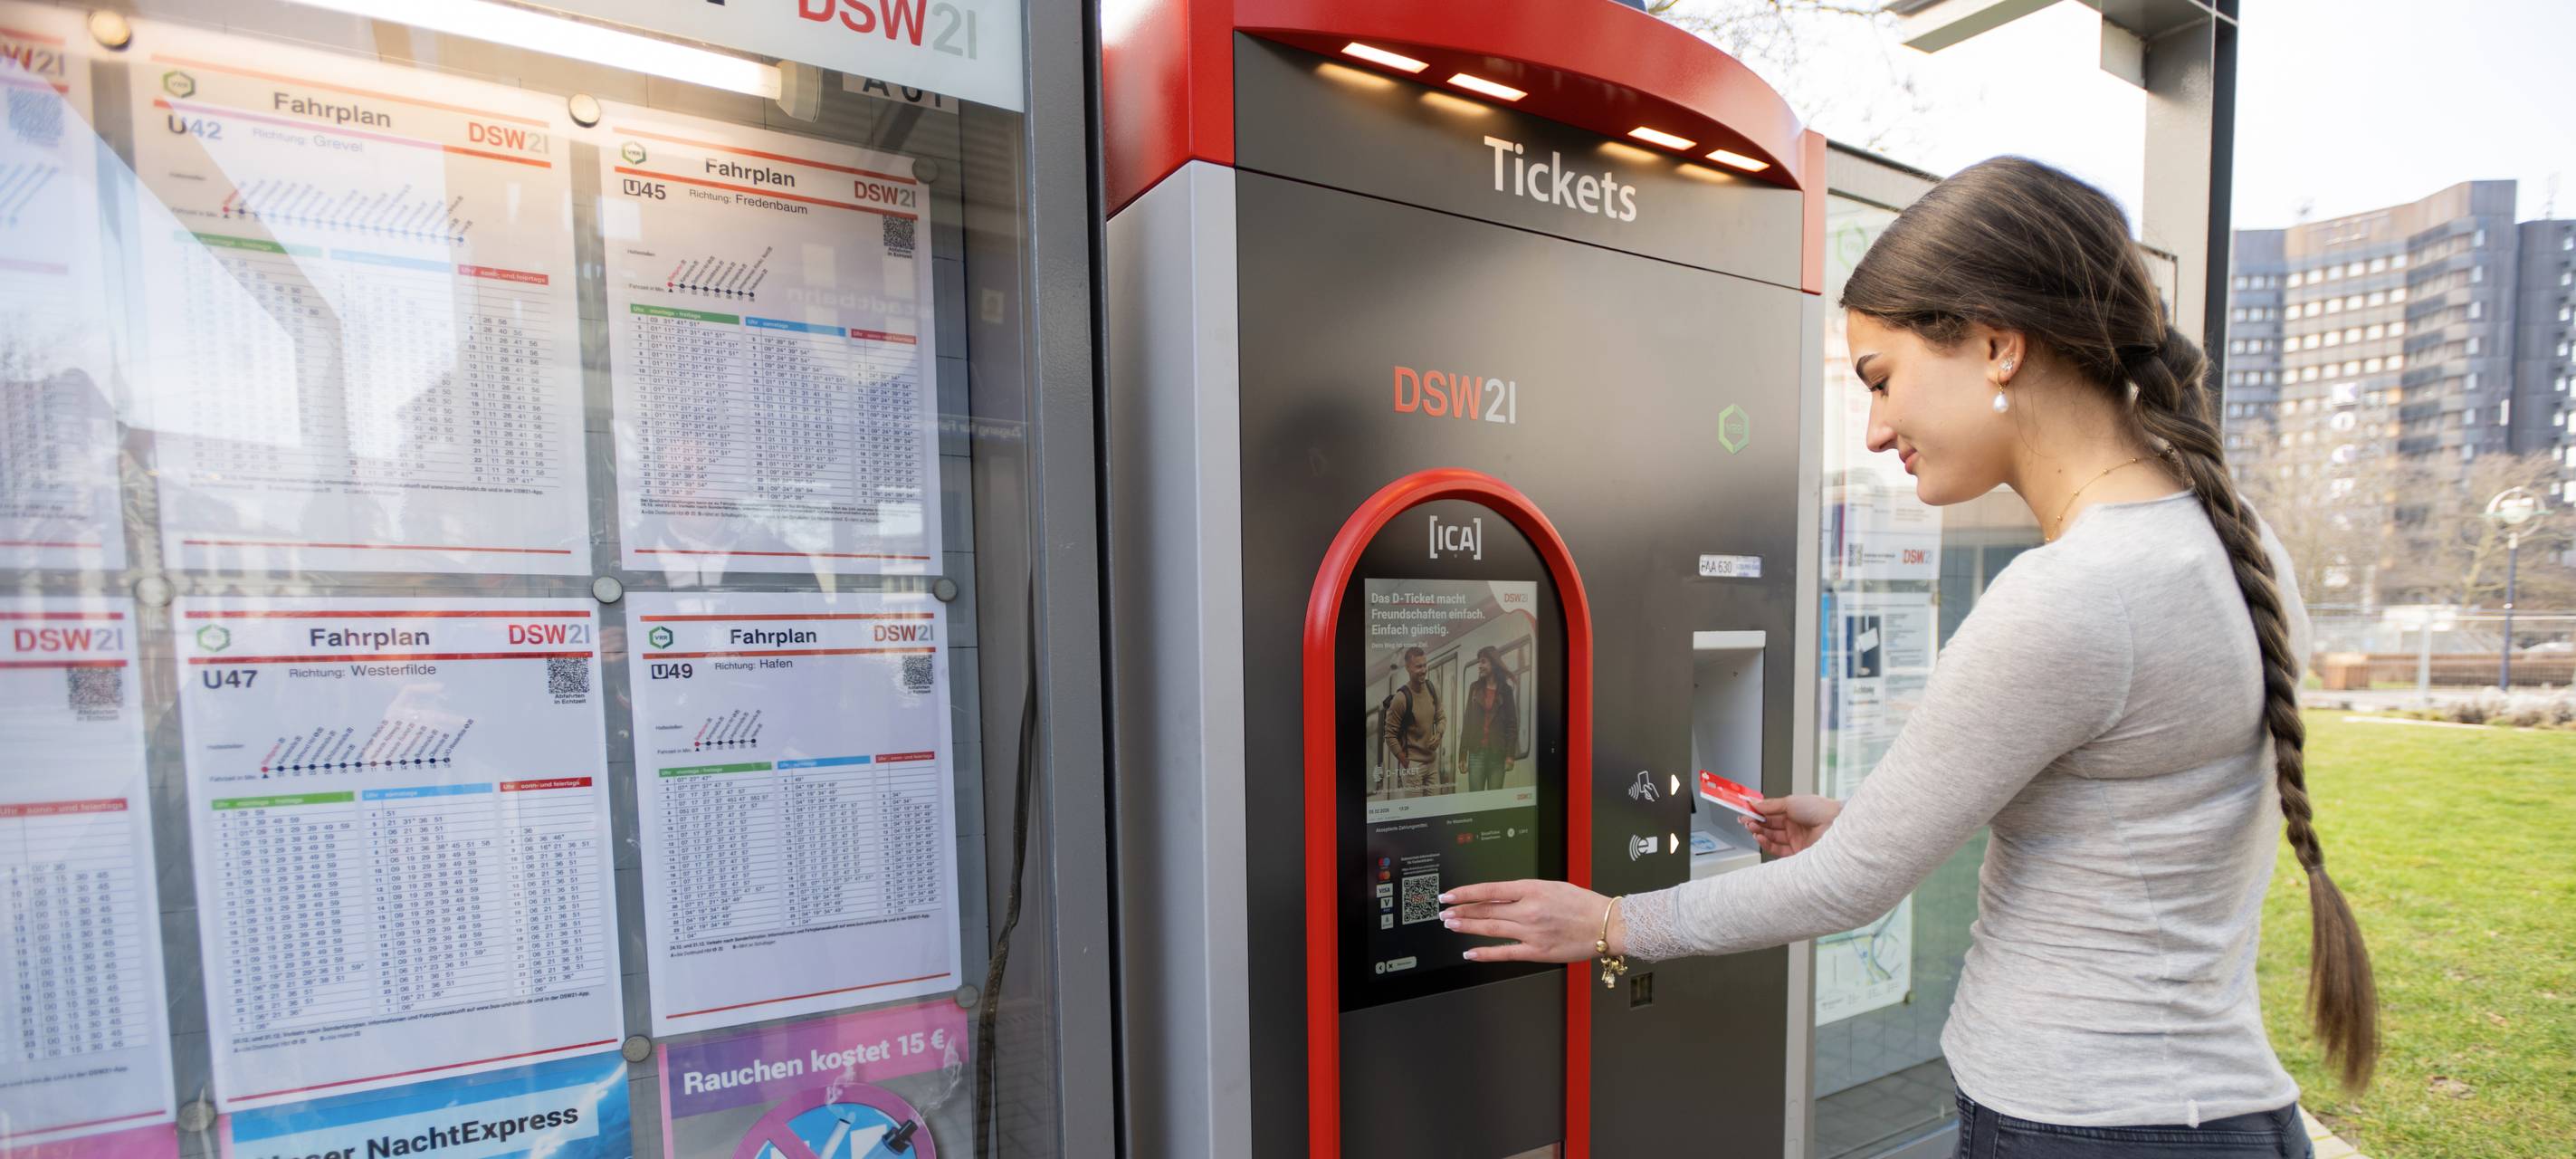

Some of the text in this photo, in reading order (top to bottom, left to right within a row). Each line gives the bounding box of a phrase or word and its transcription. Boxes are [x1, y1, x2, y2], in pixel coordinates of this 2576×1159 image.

[274, 91, 391, 127] Fahrplan
[167, 114, 222, 140] U42
[313, 134, 363, 153] Grevel
[469, 121, 549, 155] DSW21
[706, 158, 796, 187] Fahrplan
[1484, 135, 1637, 222] Tickets
[624, 179, 666, 200] U45
[854, 180, 916, 208] DSW21
[689, 188, 808, 215] Richtung: Fredenbaum
[1395, 366, 1516, 424] DSW21
[1719, 560, 1732, 573] 630
[1371, 593, 1465, 603] Das D-Ticket macht
[1371, 608, 1485, 619] Freundschaften einfach.
[14, 627, 124, 653] DSW21
[310, 628, 430, 650] Fahrplan
[509, 624, 590, 645] DSW21
[730, 629, 816, 647] Fahrplan
[874, 625, 933, 642] DSW21
[1371, 625, 1448, 637] Einfach günstig.
[289, 663, 436, 680] Richtung: Westerfilde
[652, 664, 692, 679] U49
[715, 658, 793, 671] Richtung: Hafen
[203, 669, 257, 689] U47
[683, 1029, 945, 1096] Rauchen kostet 15 €
[367, 1106, 579, 1159] NachtExpress
